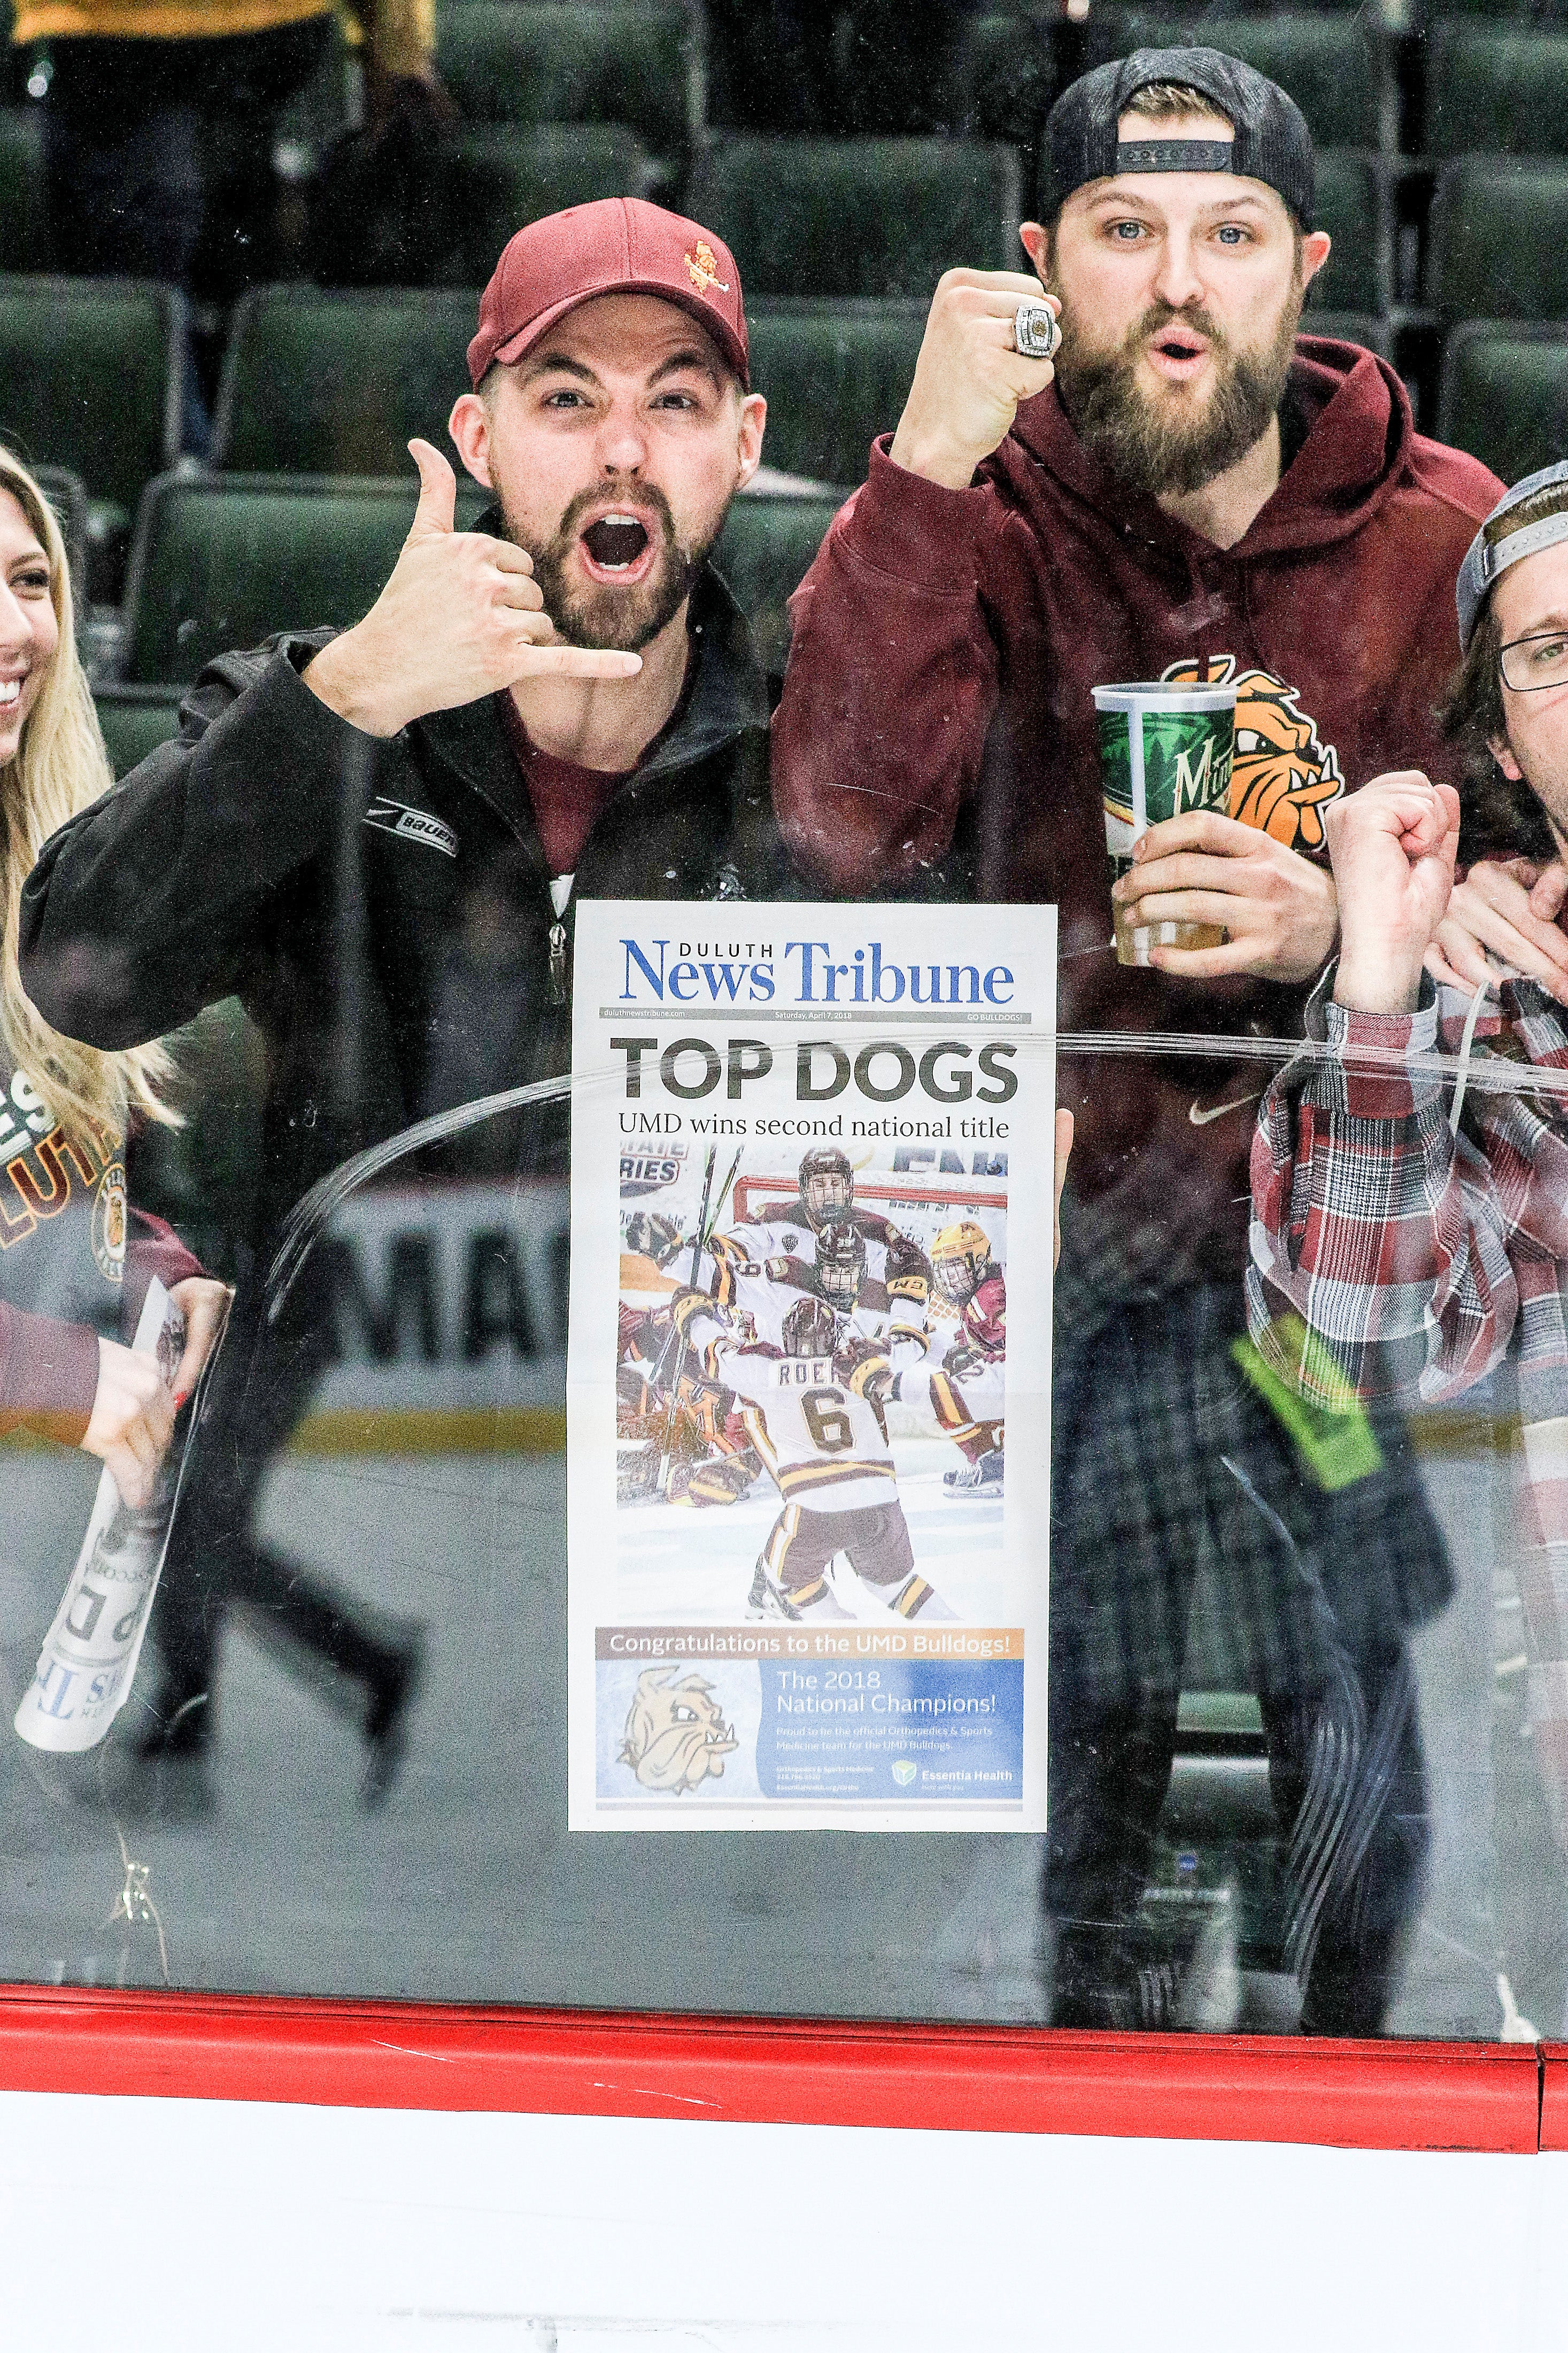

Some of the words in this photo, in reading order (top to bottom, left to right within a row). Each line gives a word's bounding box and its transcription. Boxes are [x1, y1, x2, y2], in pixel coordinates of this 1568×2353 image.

[679, 942, 773, 958] DULUTH
[619, 939, 775, 1001] News
[784, 942, 1014, 1004] Tribune
[604, 1009, 685, 1017] duluthnewstribune.com
[775, 1012, 808, 1020] Saturday,
[809, 1012, 825, 1020] April
[827, 1012, 832, 1020] 7,
[980, 1013, 1023, 1021] BULLDOGS!
[610, 1038, 773, 1099] TOP
[797, 1041, 1018, 1103] DOGS
[619, 1113, 682, 1134] UMD
[690, 1113, 747, 1135] wins
[755, 1114, 843, 1136] second
[852, 1116, 952, 1137] national
[960, 1117, 1009, 1139] title
[801, 1387, 856, 1455] 6
[610, 1633, 781, 1655] Congratulations
[787, 1635, 809, 1652] to
[814, 1634, 850, 1652] the
[856, 1635, 907, 1653] UMD
[913, 1634, 1009, 1656] Bulldogs!
[777, 1670, 817, 1689] The
[824, 1671, 881, 1690] 2018
[777, 1693, 864, 1713] National
[871, 1693, 995, 1716] Champions!
[777, 1727, 805, 1735] Proud
[835, 1726, 851, 1735] the
[853, 1726, 886, 1736] official
[888, 1726, 948, 1737] Orthopedics
[949, 1727, 957, 1736] &
[960, 1727, 993, 1737] Sports
[777, 1741, 819, 1750] Medicine
[822, 1742, 846, 1750] team
[848, 1741, 862, 1749] for
[864, 1741, 881, 1749] the
[883, 1741, 907, 1749] UMD
[909, 1741, 953, 1751] Bulldogs.
[922, 1770, 972, 1781] Essentia
[974, 1770, 1013, 1781] Health
